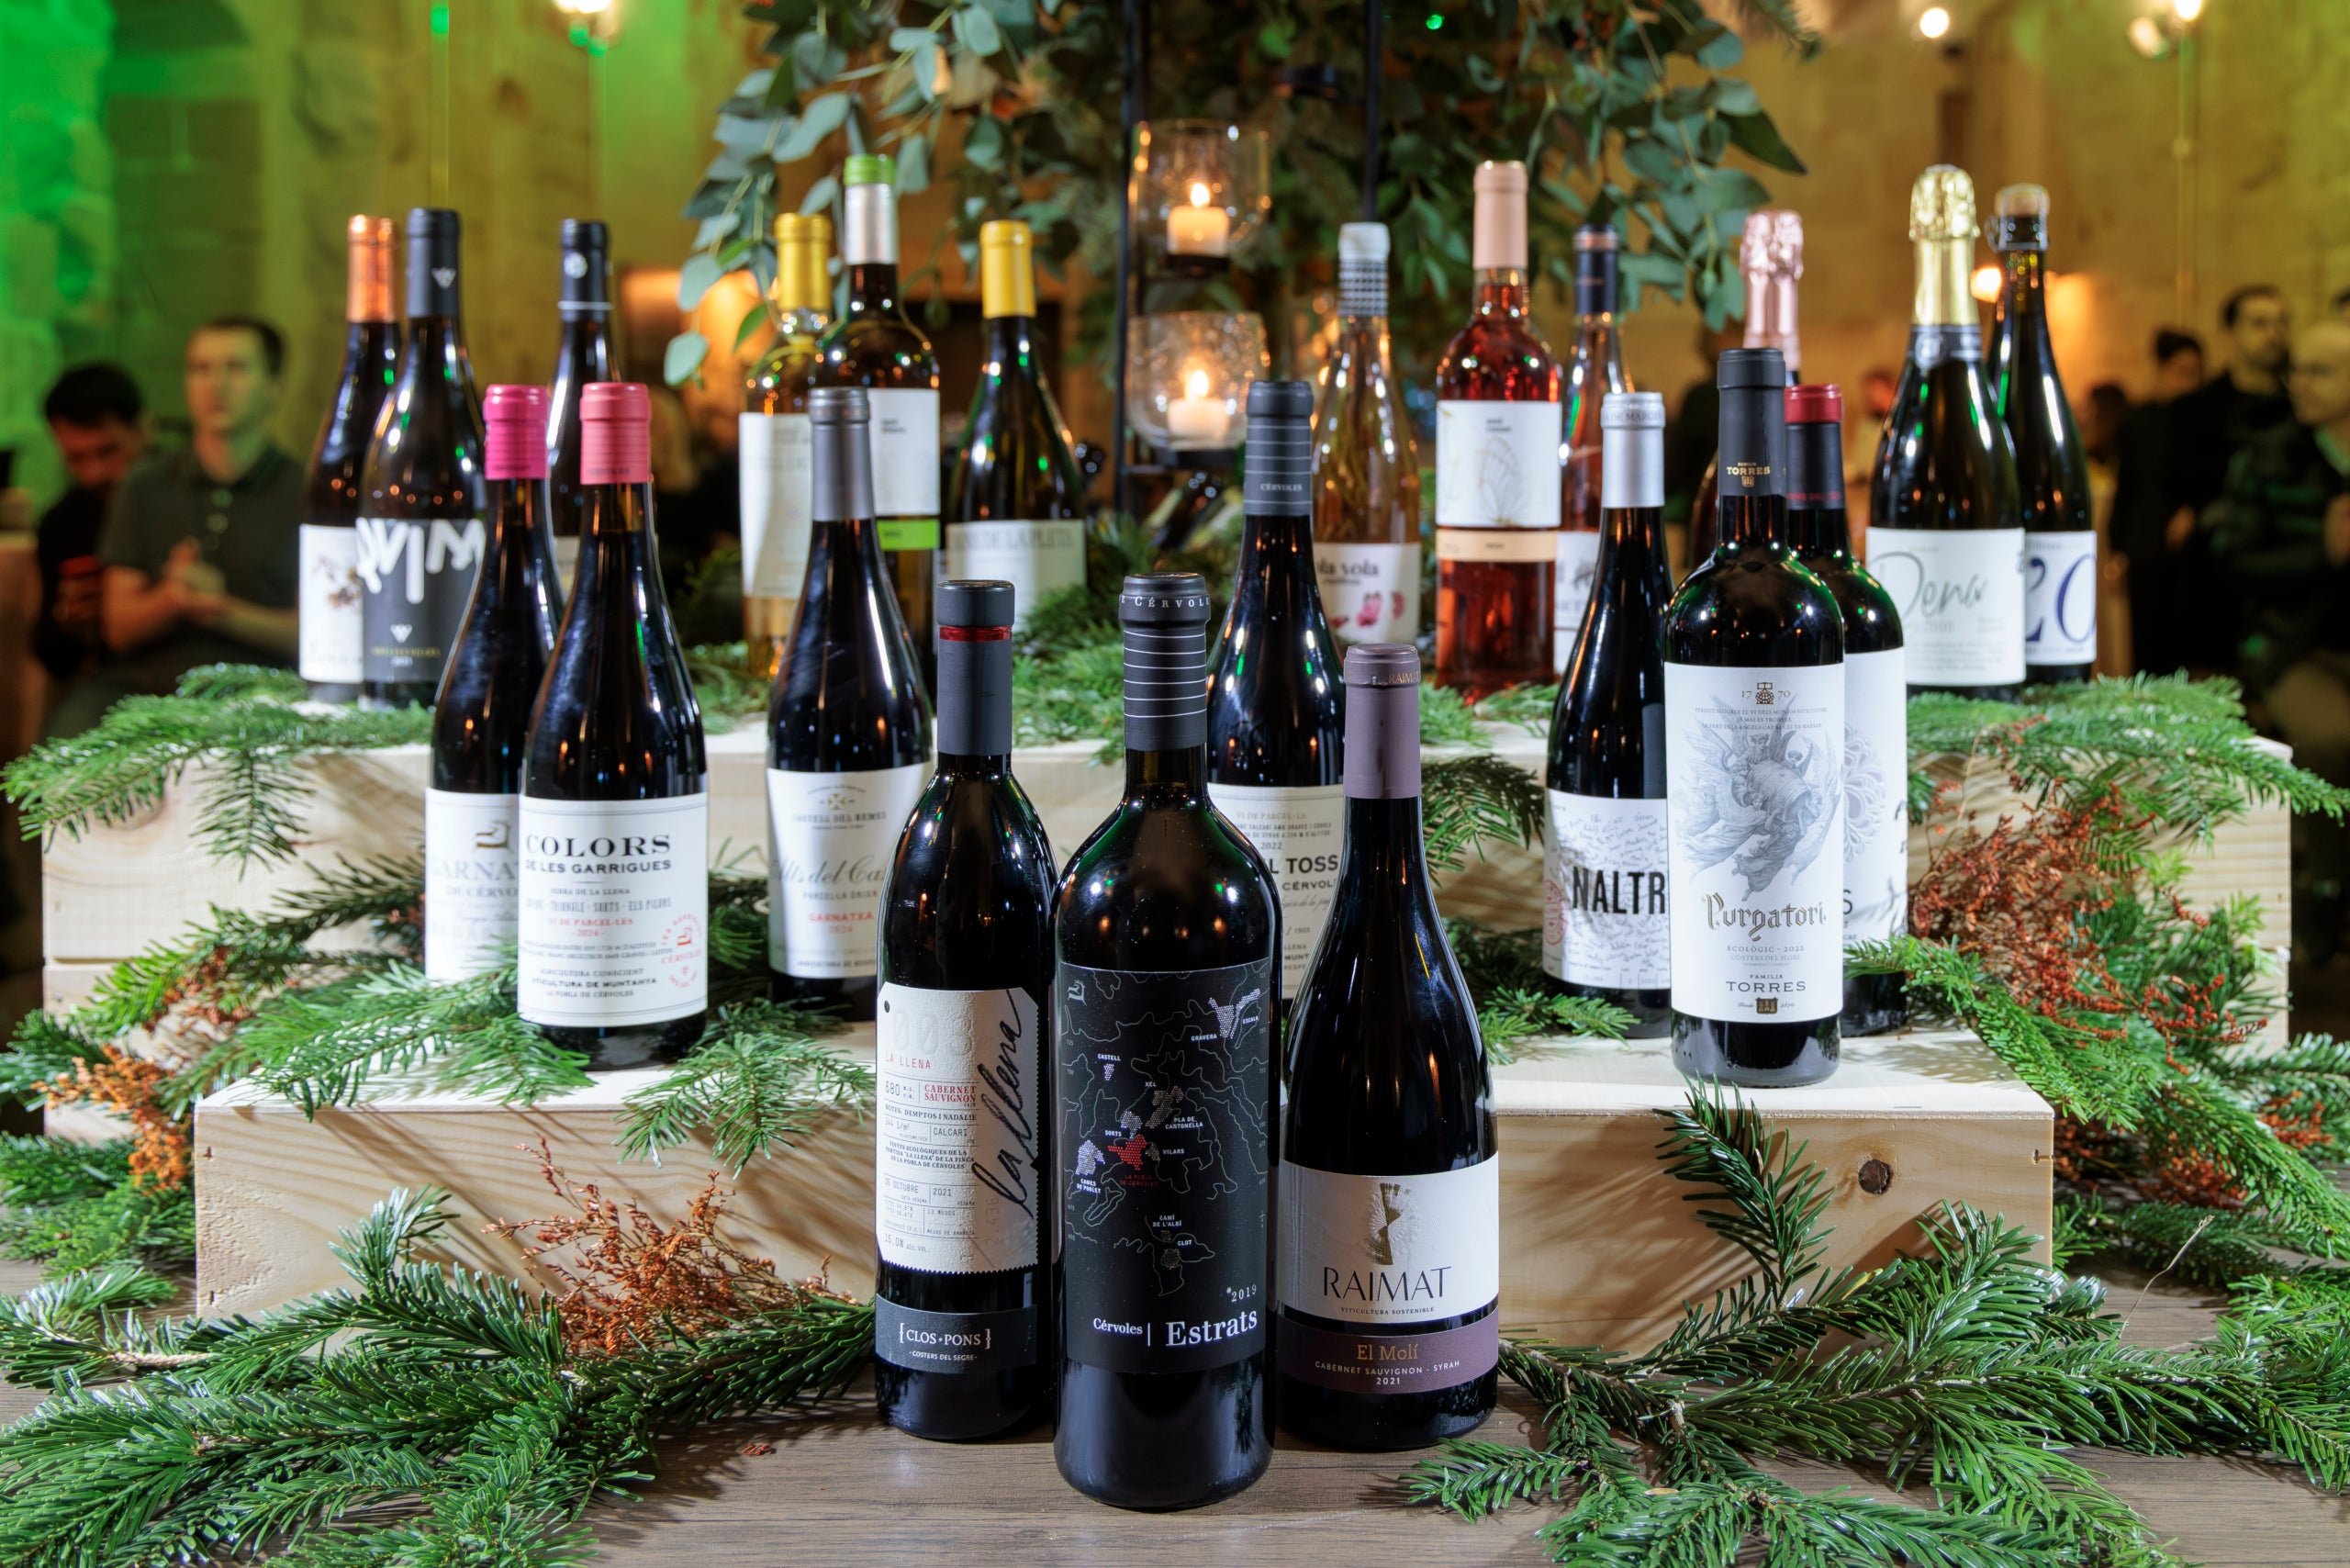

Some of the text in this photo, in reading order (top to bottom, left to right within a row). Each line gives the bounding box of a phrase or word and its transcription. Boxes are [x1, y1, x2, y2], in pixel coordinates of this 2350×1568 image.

[1726, 466, 1771, 475] TORRES
[526, 834, 671, 858] COLORS
[1260, 842, 1282, 850] 2022
[526, 859, 672, 874] DE LES GARRIGUES
[1285, 854, 1338, 874] TOSS
[1281, 879, 1337, 890] CÉRVOL
[1572, 866, 1665, 915] NALTR
[1702, 891, 1827, 942] Purgatori
[1726, 980, 1807, 992] TORRES
[1242, 1016, 1259, 1025] ESCALA
[1191, 1033, 1217, 1042] GRAVERA
[886, 1052, 931, 1070] LA LLENA
[1097, 1053, 1122, 1061] CASTELL
[886, 1081, 901, 1096] 680
[924, 1084, 977, 1094] CABERNET
[924, 1092, 976, 1103] SAUVIGNON
[904, 1109, 937, 1119] DEMPTOS
[1165, 1122, 1203, 1130] CANTONELLA
[934, 1127, 968, 1137] CALCARI
[906, 1145, 946, 1156] ECOLÒGIQUES
[903, 1159, 922, 1167] POBLA
[932, 1160, 965, 1170] CÉRVOLES
[892, 1180, 919, 1194] OCTUBRE
[933, 1187, 952, 1197] 2021
[1083, 1184, 1102, 1193] POBLET
[1324, 1265, 1452, 1303] RAIMAT
[1340, 1306, 1436, 1316] VITICULTURA SOSTENIBLE
[1092, 1310, 1258, 1347] Cérvoles Estrats
[1357, 1343, 1419, 1361] El Molí
[1315, 1360, 1460, 1376] CABERNET SAUVIGNON SYRAH
[1376, 1377, 1401, 1385] 2021
